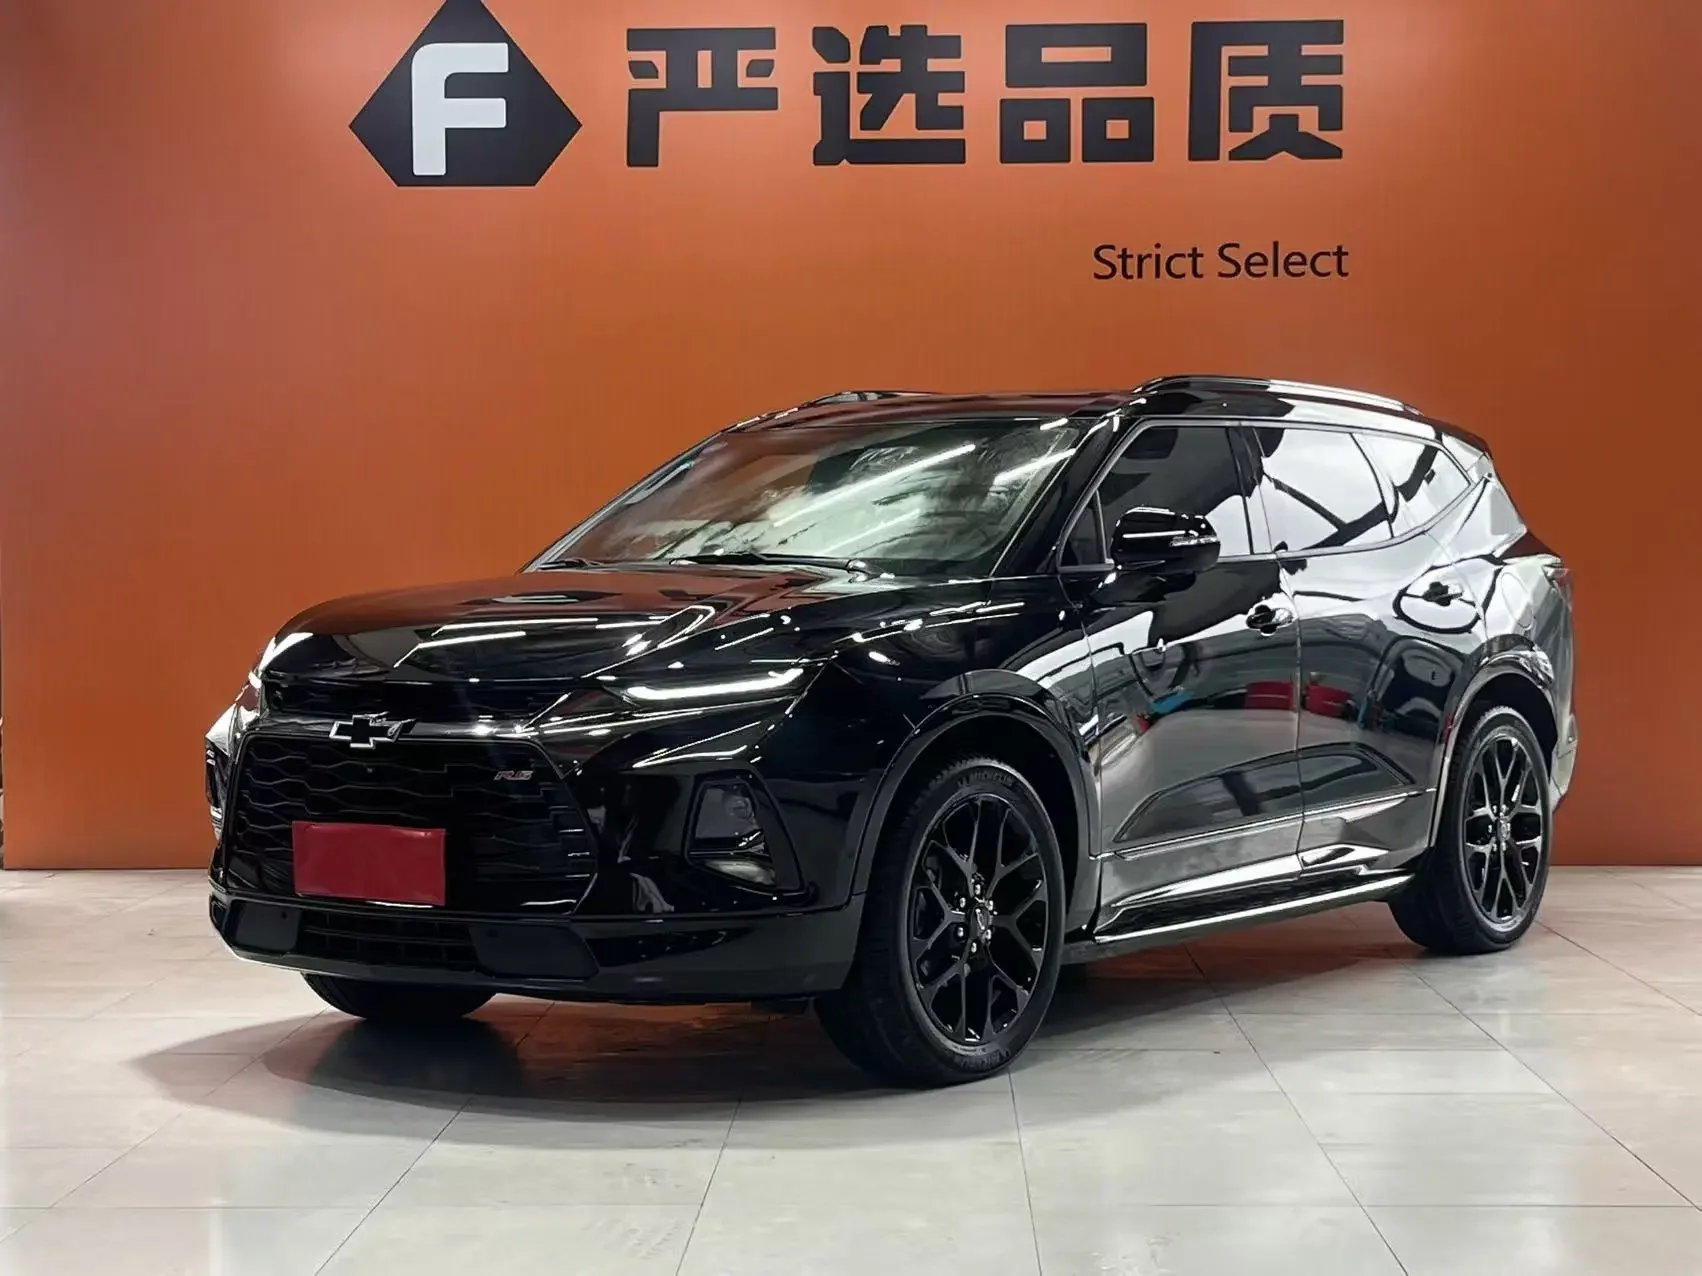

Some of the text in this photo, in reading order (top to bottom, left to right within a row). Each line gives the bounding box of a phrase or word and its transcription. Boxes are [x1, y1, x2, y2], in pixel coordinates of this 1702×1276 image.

[411, 42, 509, 176] F
[626, 19, 1345, 168] 严选品质
[1093, 240, 1349, 280] Strict Select
